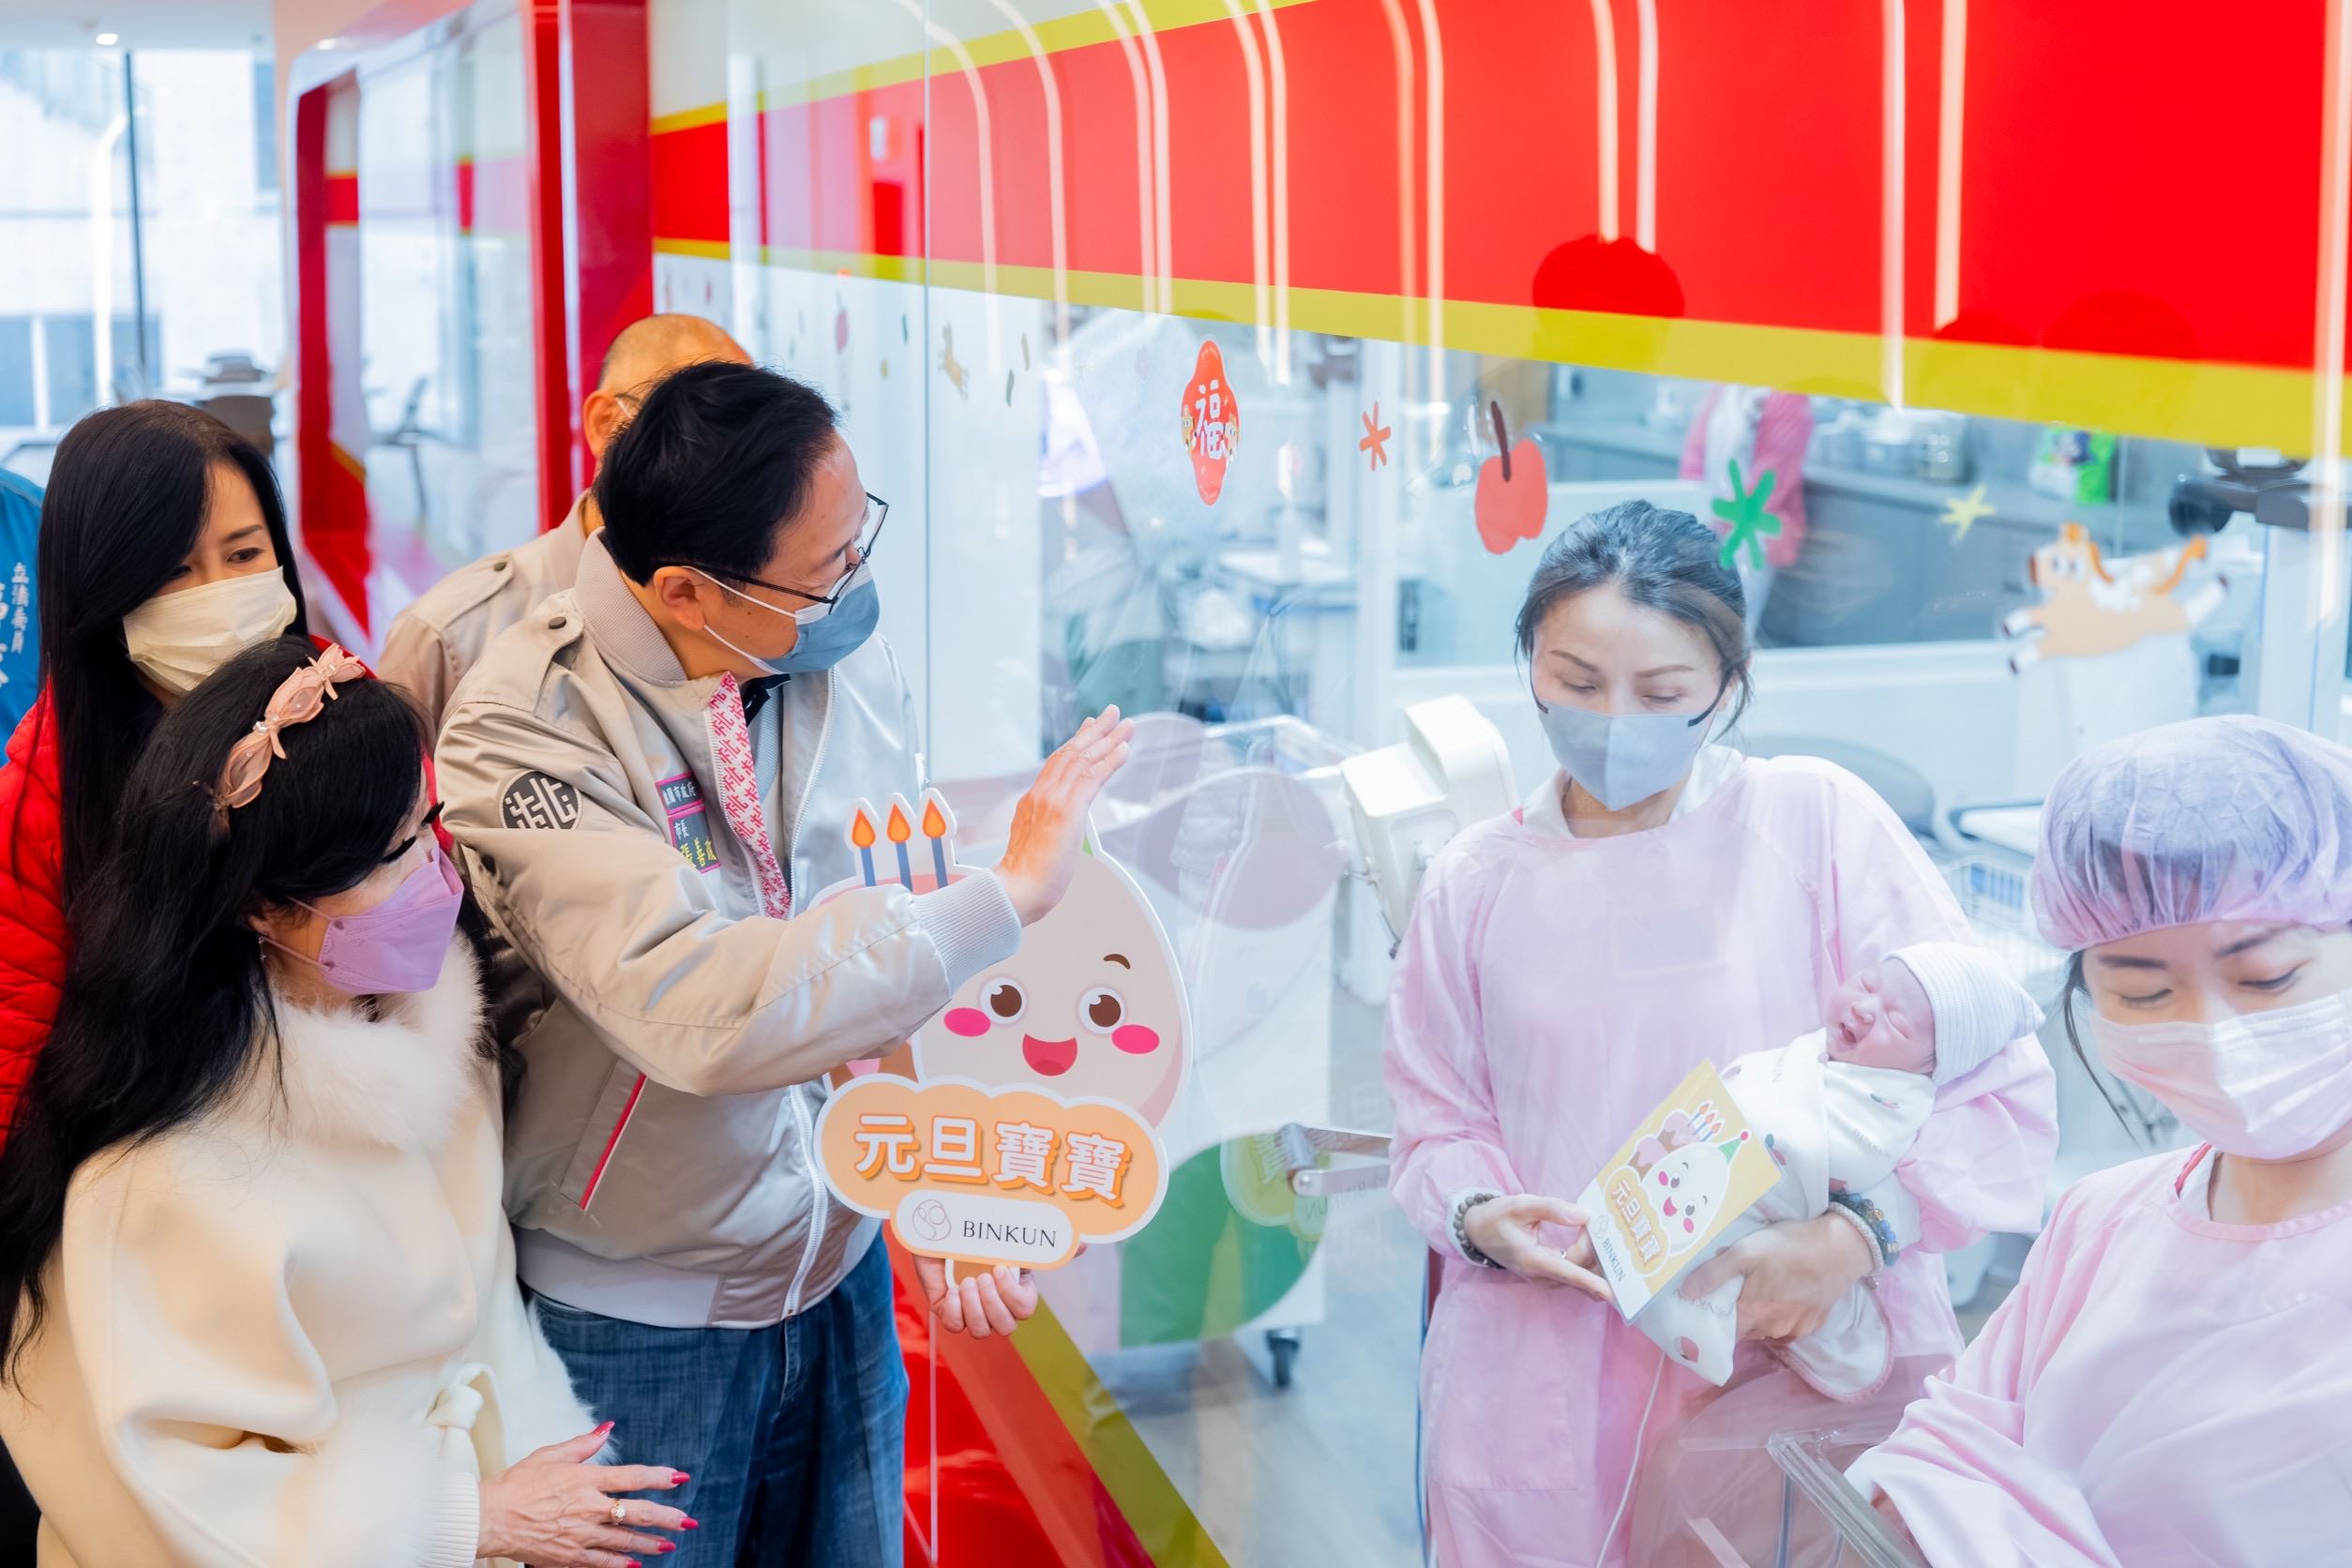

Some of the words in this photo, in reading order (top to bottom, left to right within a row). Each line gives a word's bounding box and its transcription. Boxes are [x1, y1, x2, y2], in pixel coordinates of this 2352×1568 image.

[1195, 379, 1225, 460] 福
[854, 1113, 1128, 1206] 元旦寶寶
[963, 1220, 1057, 1248] BINKUN
[1603, 1237, 1627, 1282] BINKUN
[1610, 1179, 1661, 1266] 元旦寶寶
